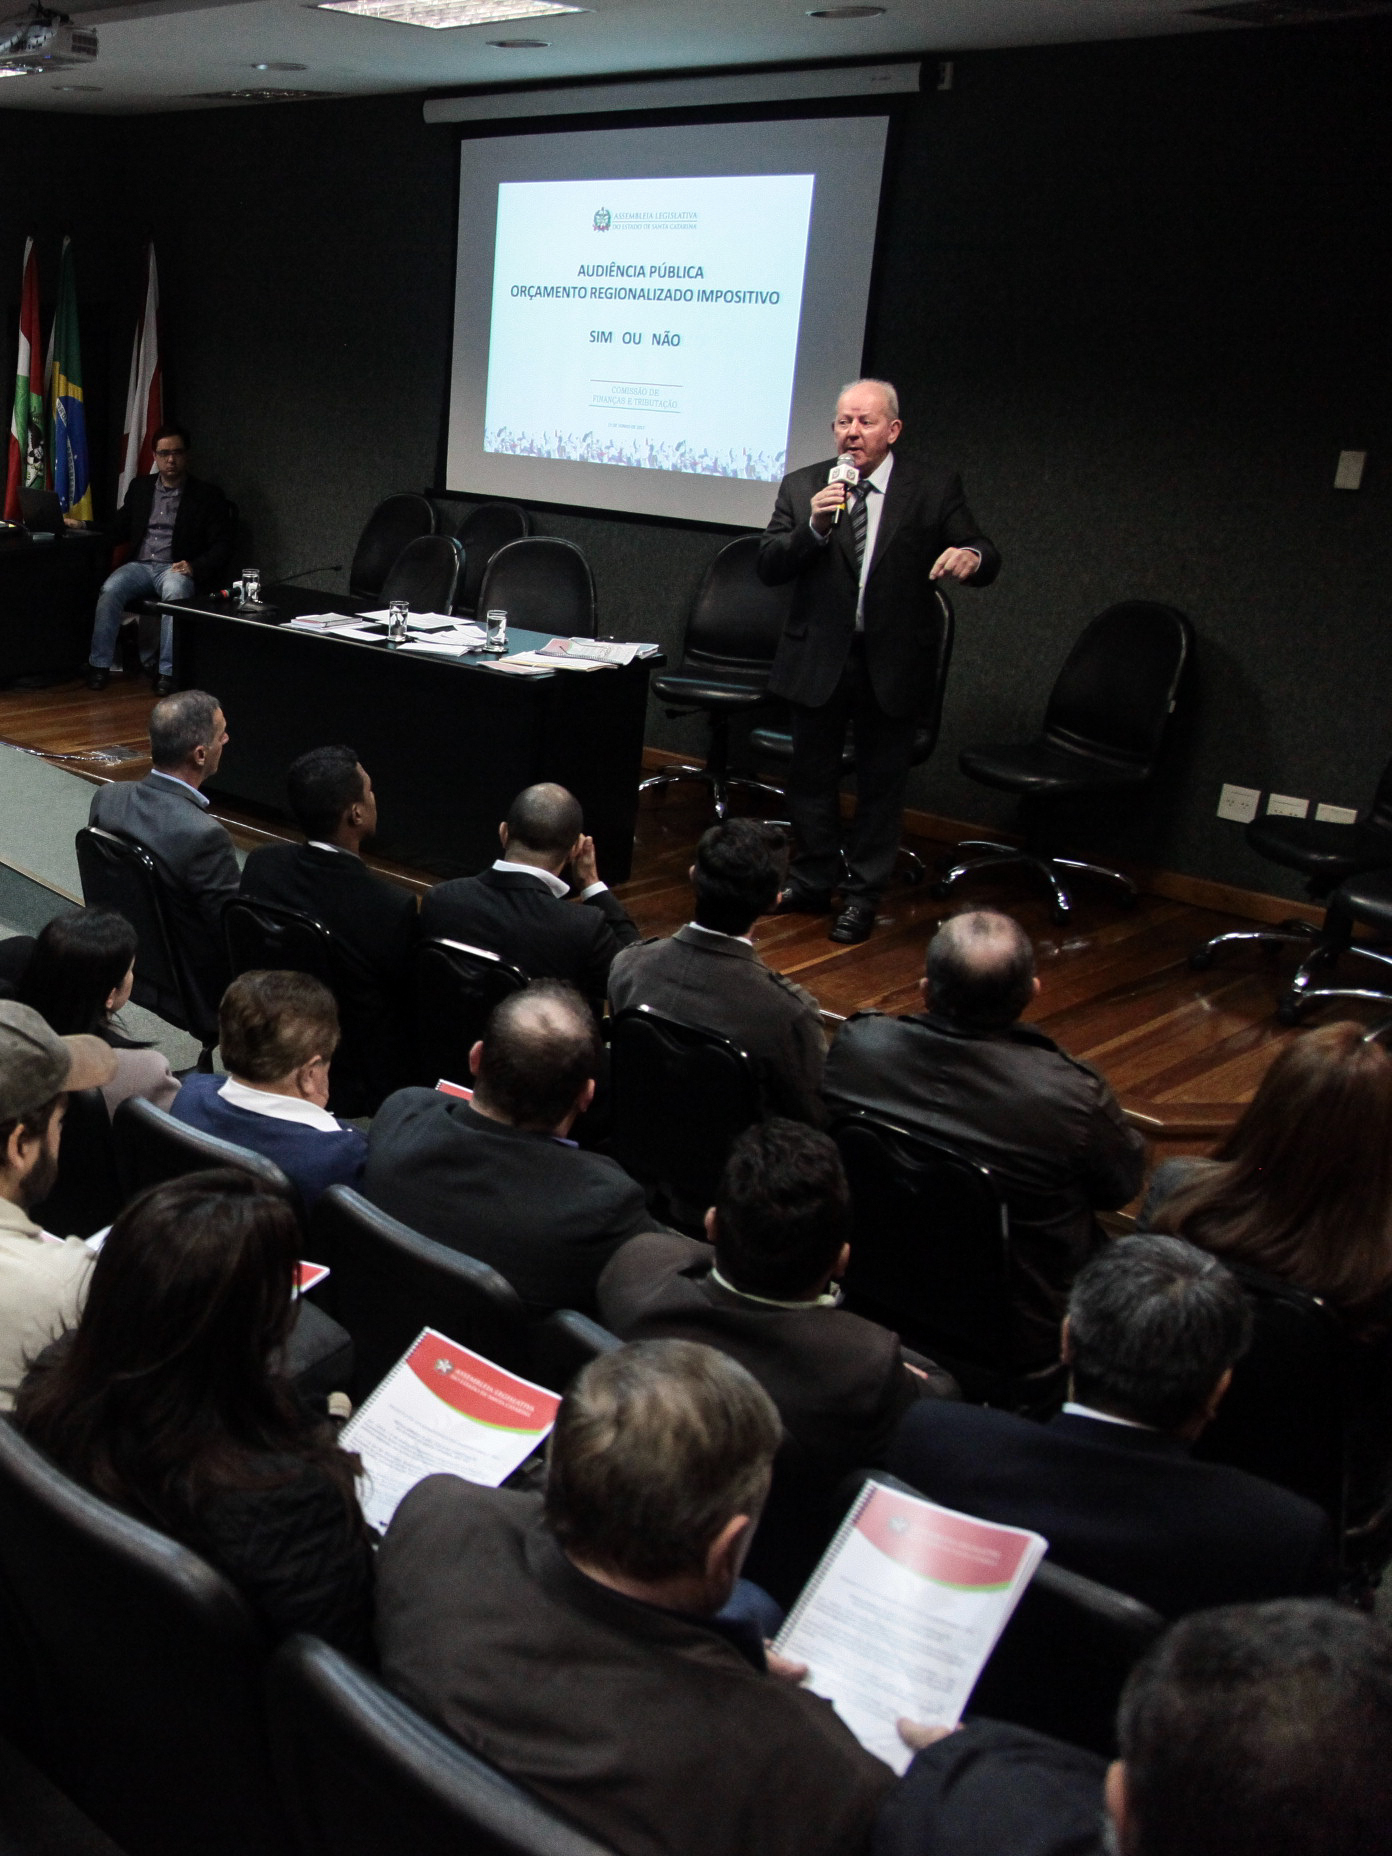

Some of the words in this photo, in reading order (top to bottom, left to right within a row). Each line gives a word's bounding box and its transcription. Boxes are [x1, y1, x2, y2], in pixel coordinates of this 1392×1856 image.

[577, 261, 647, 279] AUDIÊNCIA
[649, 262, 705, 280] PÚBLICA
[510, 285, 587, 301] ORÇAMENTO
[589, 286, 694, 303] REGIONALIZADO
[696, 289, 780, 305] IMPOSITIVO
[589, 329, 613, 344] SIM
[622, 331, 642, 345] OU
[651, 330, 681, 347] NÃO
[592, 394, 626, 406] FINANÇAS
[634, 398, 678, 409] TRIBUTAÇÃO
[649, 388, 660, 397] DE
